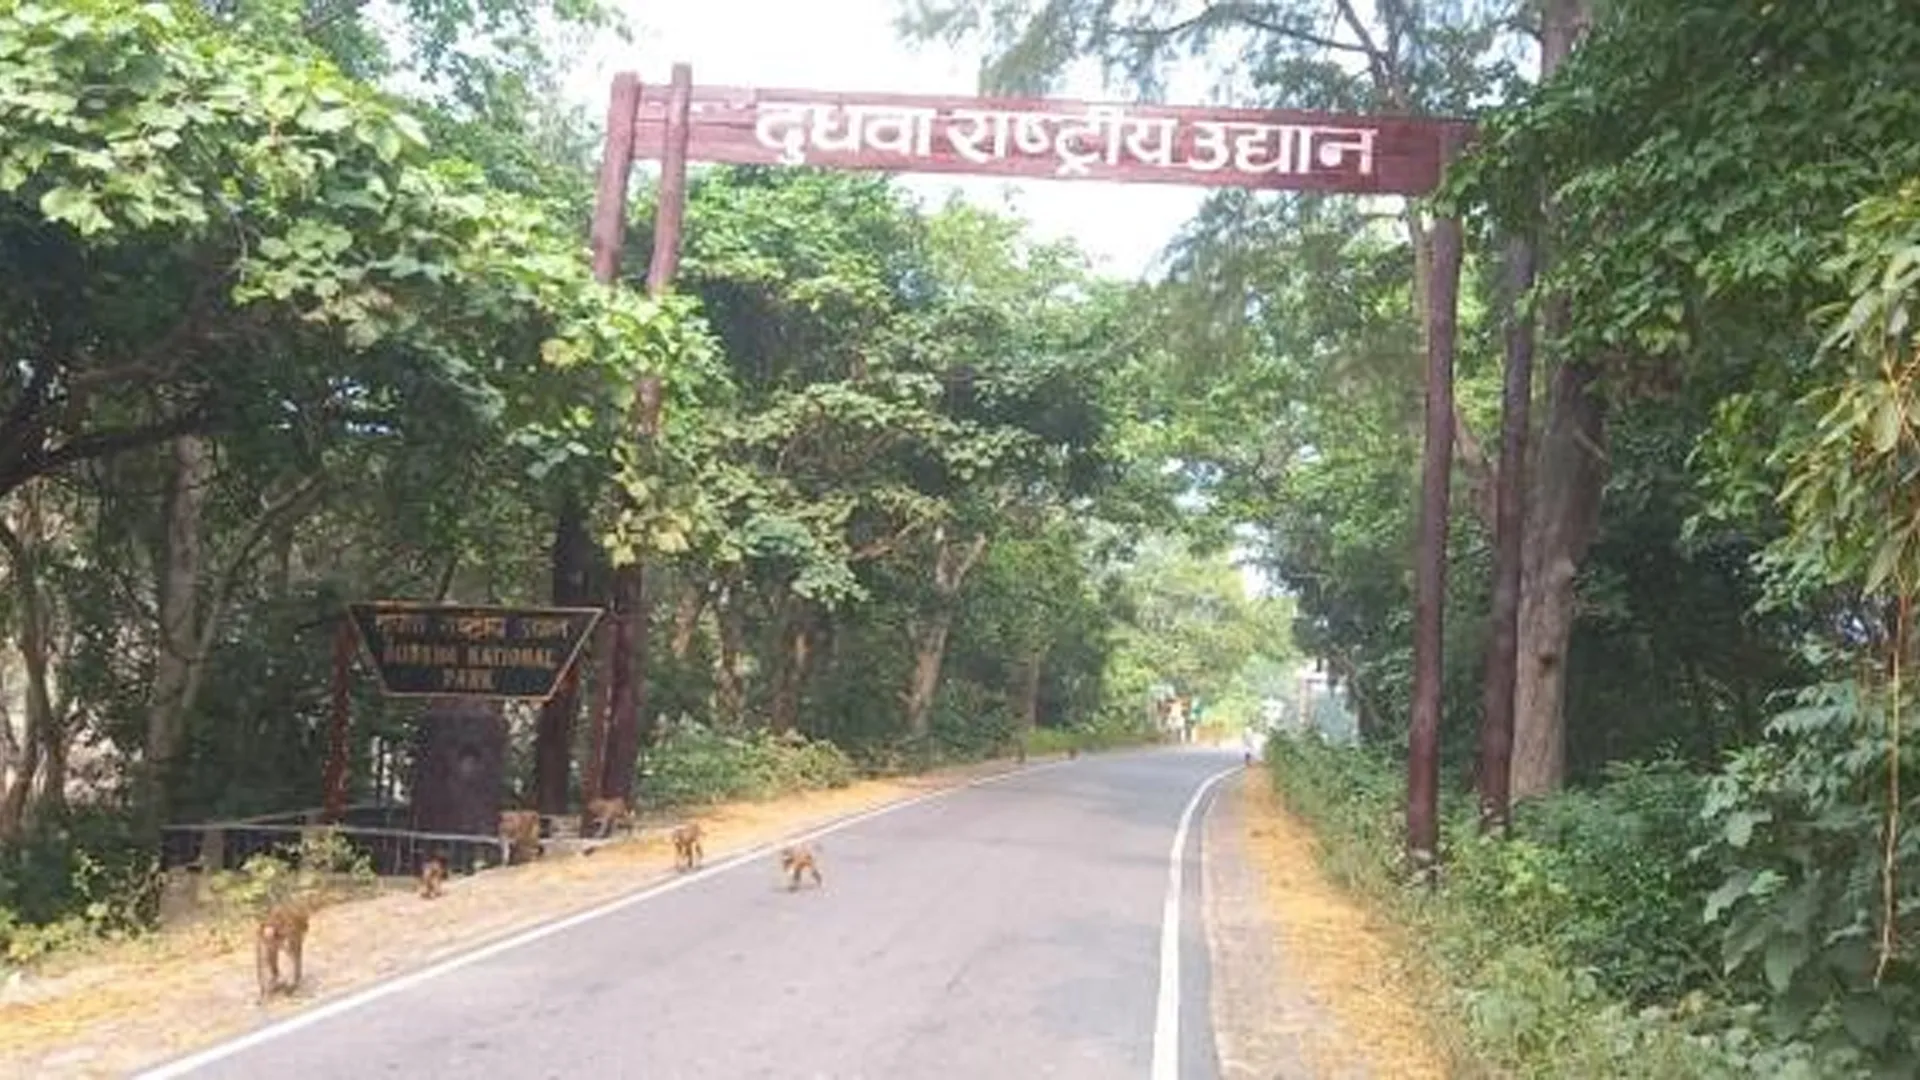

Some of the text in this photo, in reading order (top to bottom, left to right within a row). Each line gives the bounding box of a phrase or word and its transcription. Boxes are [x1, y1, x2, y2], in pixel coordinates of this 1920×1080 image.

[756, 102, 1378, 174] दुधवा राष्ट्रीय उद्यान
